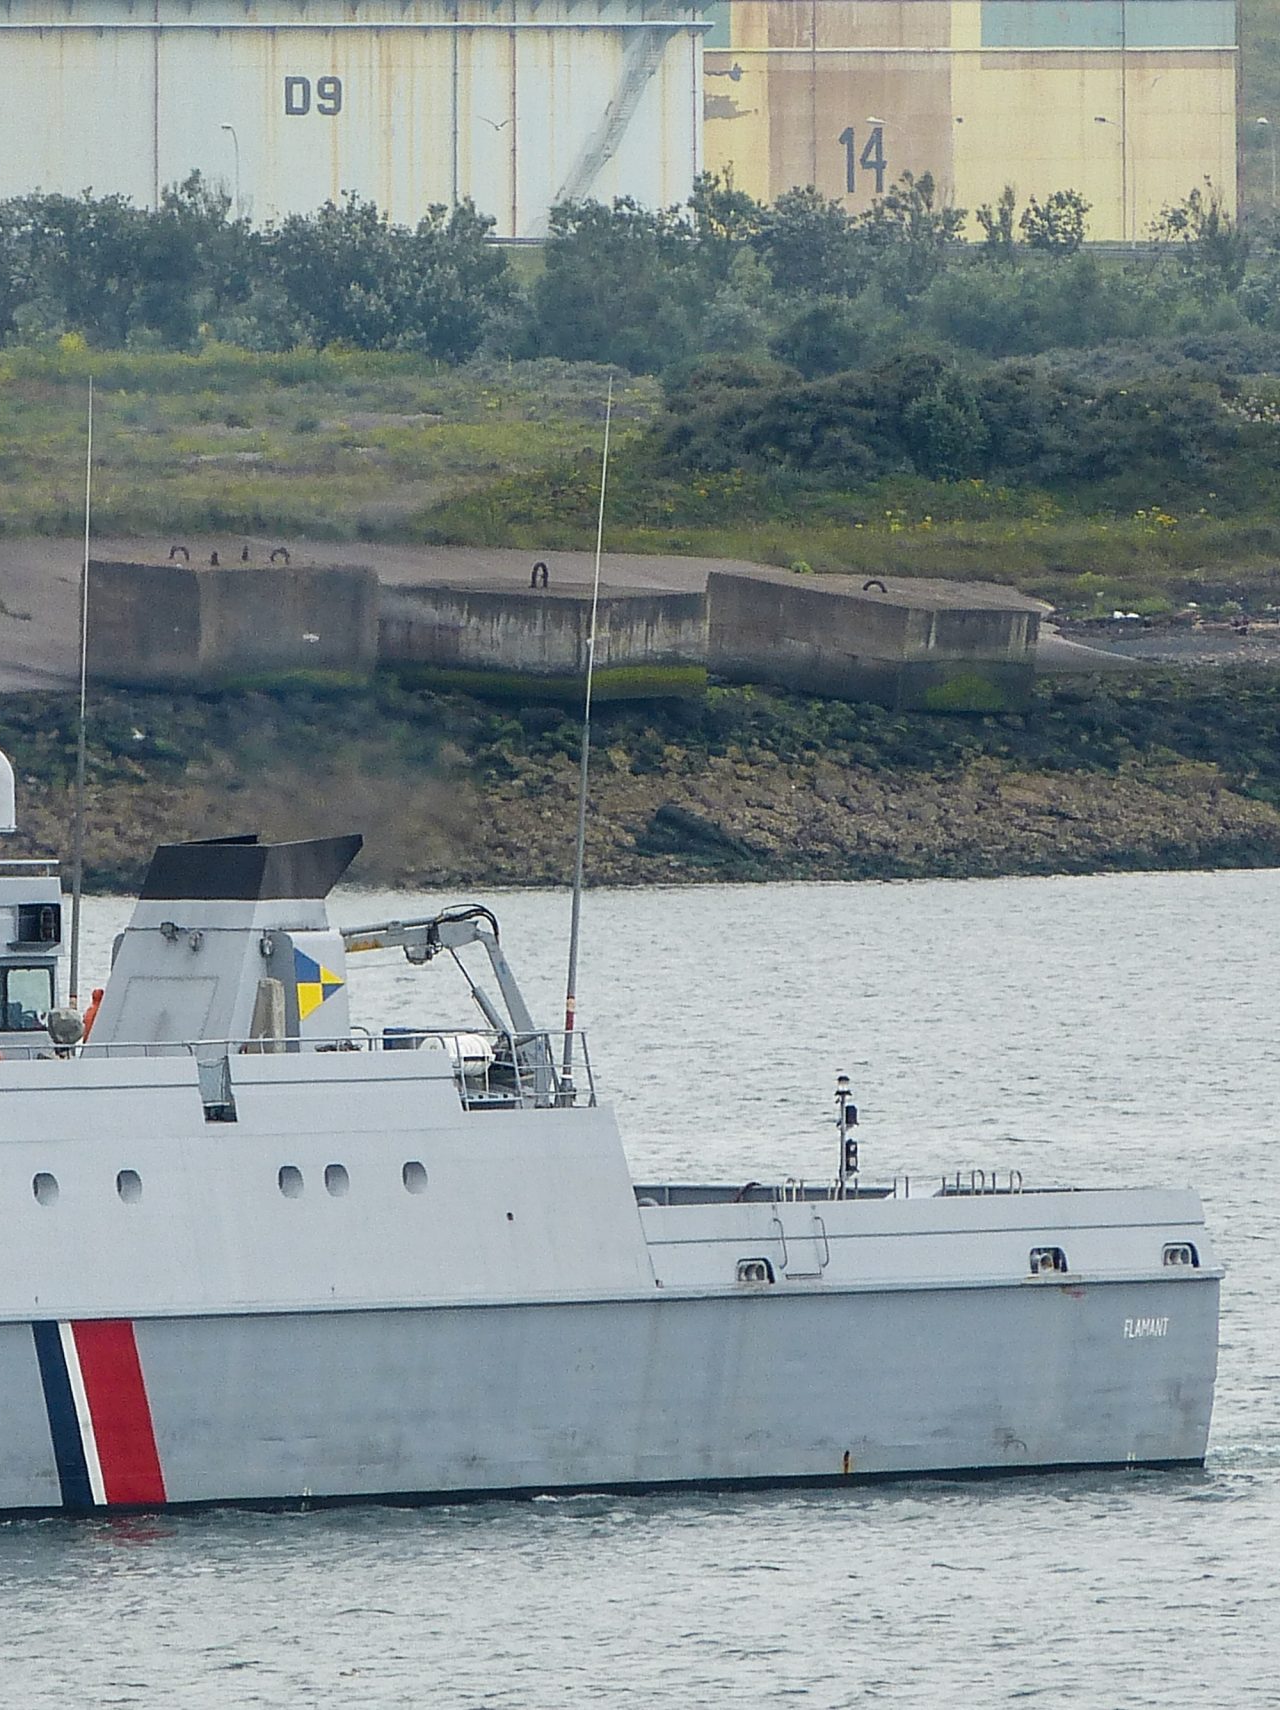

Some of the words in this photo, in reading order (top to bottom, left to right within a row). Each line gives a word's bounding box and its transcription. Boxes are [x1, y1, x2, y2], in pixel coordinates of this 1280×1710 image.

[285, 76, 342, 115] D9
[839, 127, 887, 193] 14
[1124, 1317, 1169, 1338] FLAMANT
